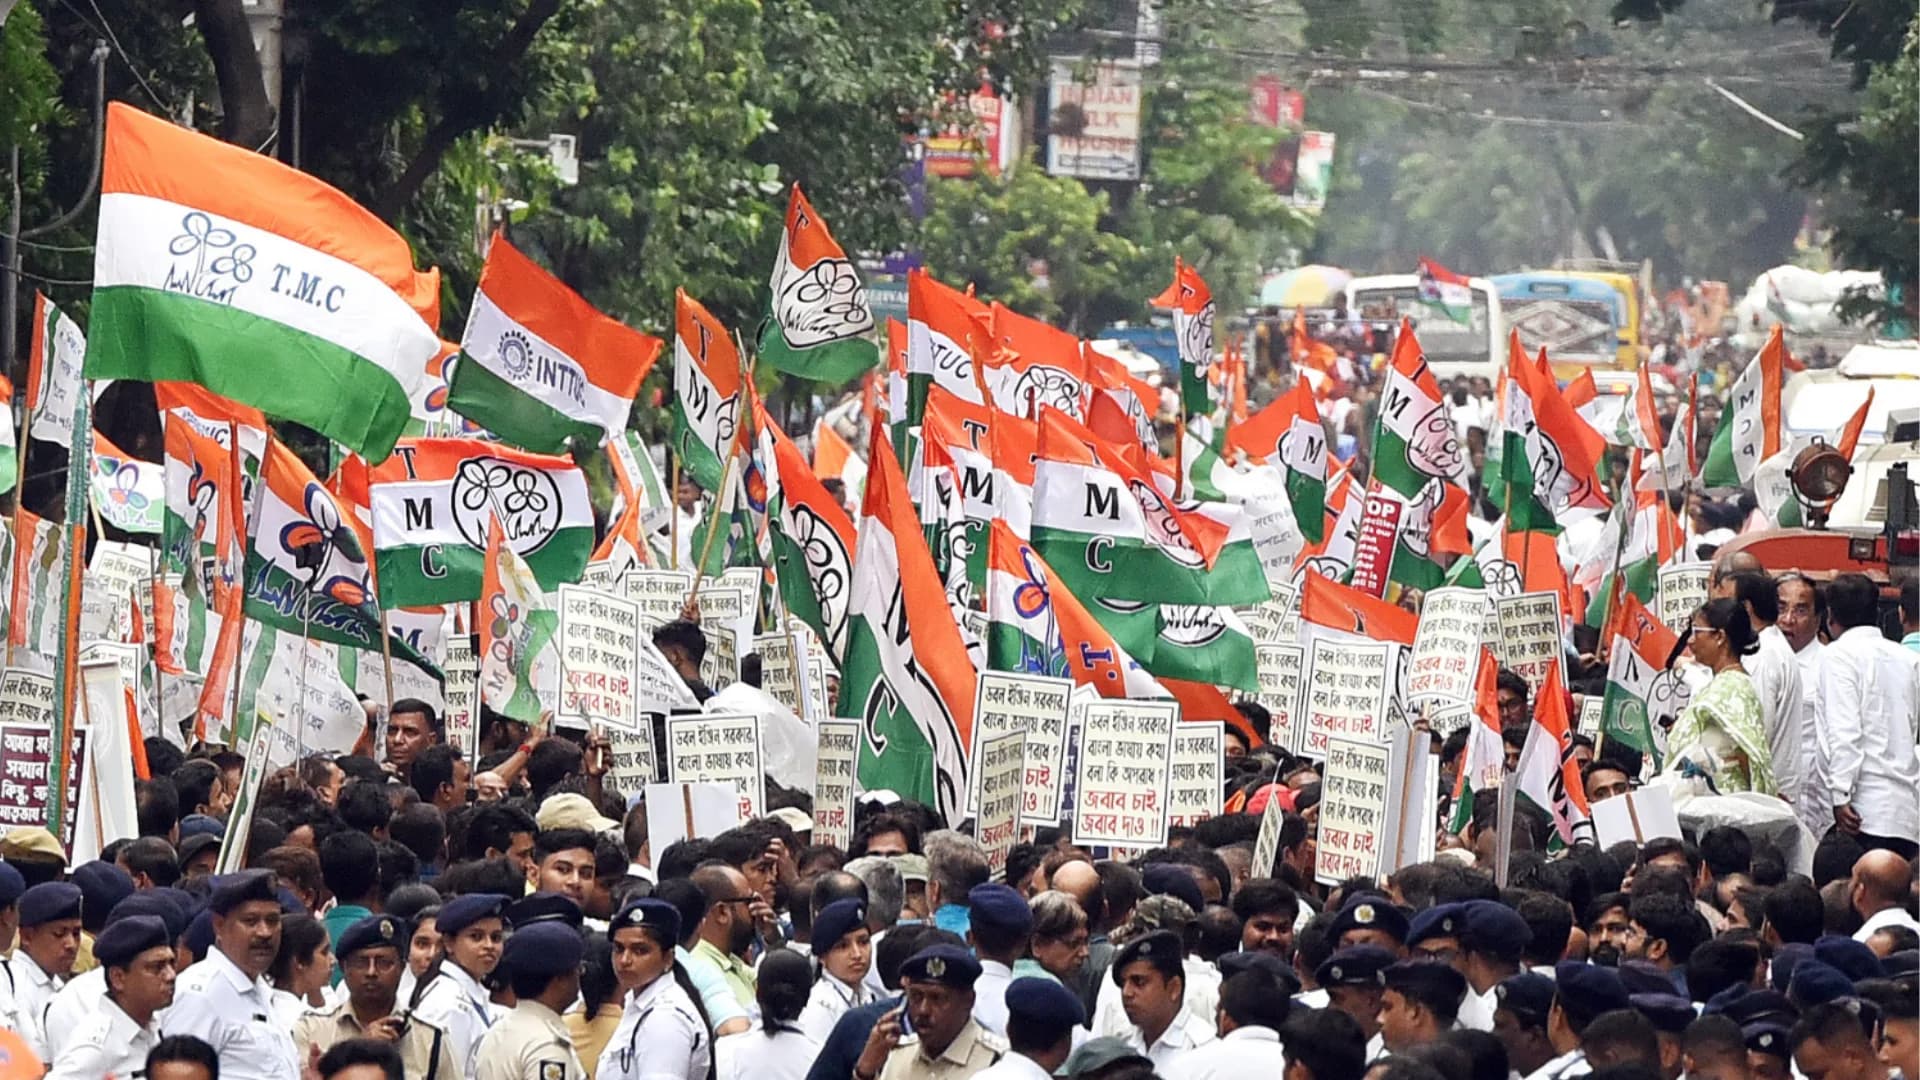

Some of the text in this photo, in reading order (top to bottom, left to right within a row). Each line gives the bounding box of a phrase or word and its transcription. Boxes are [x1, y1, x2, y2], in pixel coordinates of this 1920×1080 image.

[271, 263, 346, 313] T.M.C
[985, 686, 1006, 705] ডবল
[1008, 683, 1031, 708] ইঞ্জিন
[983, 711, 1007, 730] বাংলা
[1041, 719, 1062, 737] কথা
[1090, 714, 1110, 733] ডবল
[1113, 711, 1134, 733] ইঞ্জিন
[675, 729, 696, 747] ডবল
[698, 726, 721, 745] ইঞ্জিন
[677, 754, 702, 772] বাংলা
[735, 752, 755, 768] কথা
[1026, 742, 1050, 761] পরাধ
[1088, 739, 1166, 761] বাংলা ভাষায় কথা
[1087, 764, 1103, 782] বলা
[1107, 760, 1118, 783] কি
[1122, 765, 1154, 785] অপরাধ
[1084, 789, 1160, 814] জবাব চাই,
[1082, 813, 1118, 836] জবাব
[1122, 816, 1145, 837] দাও
